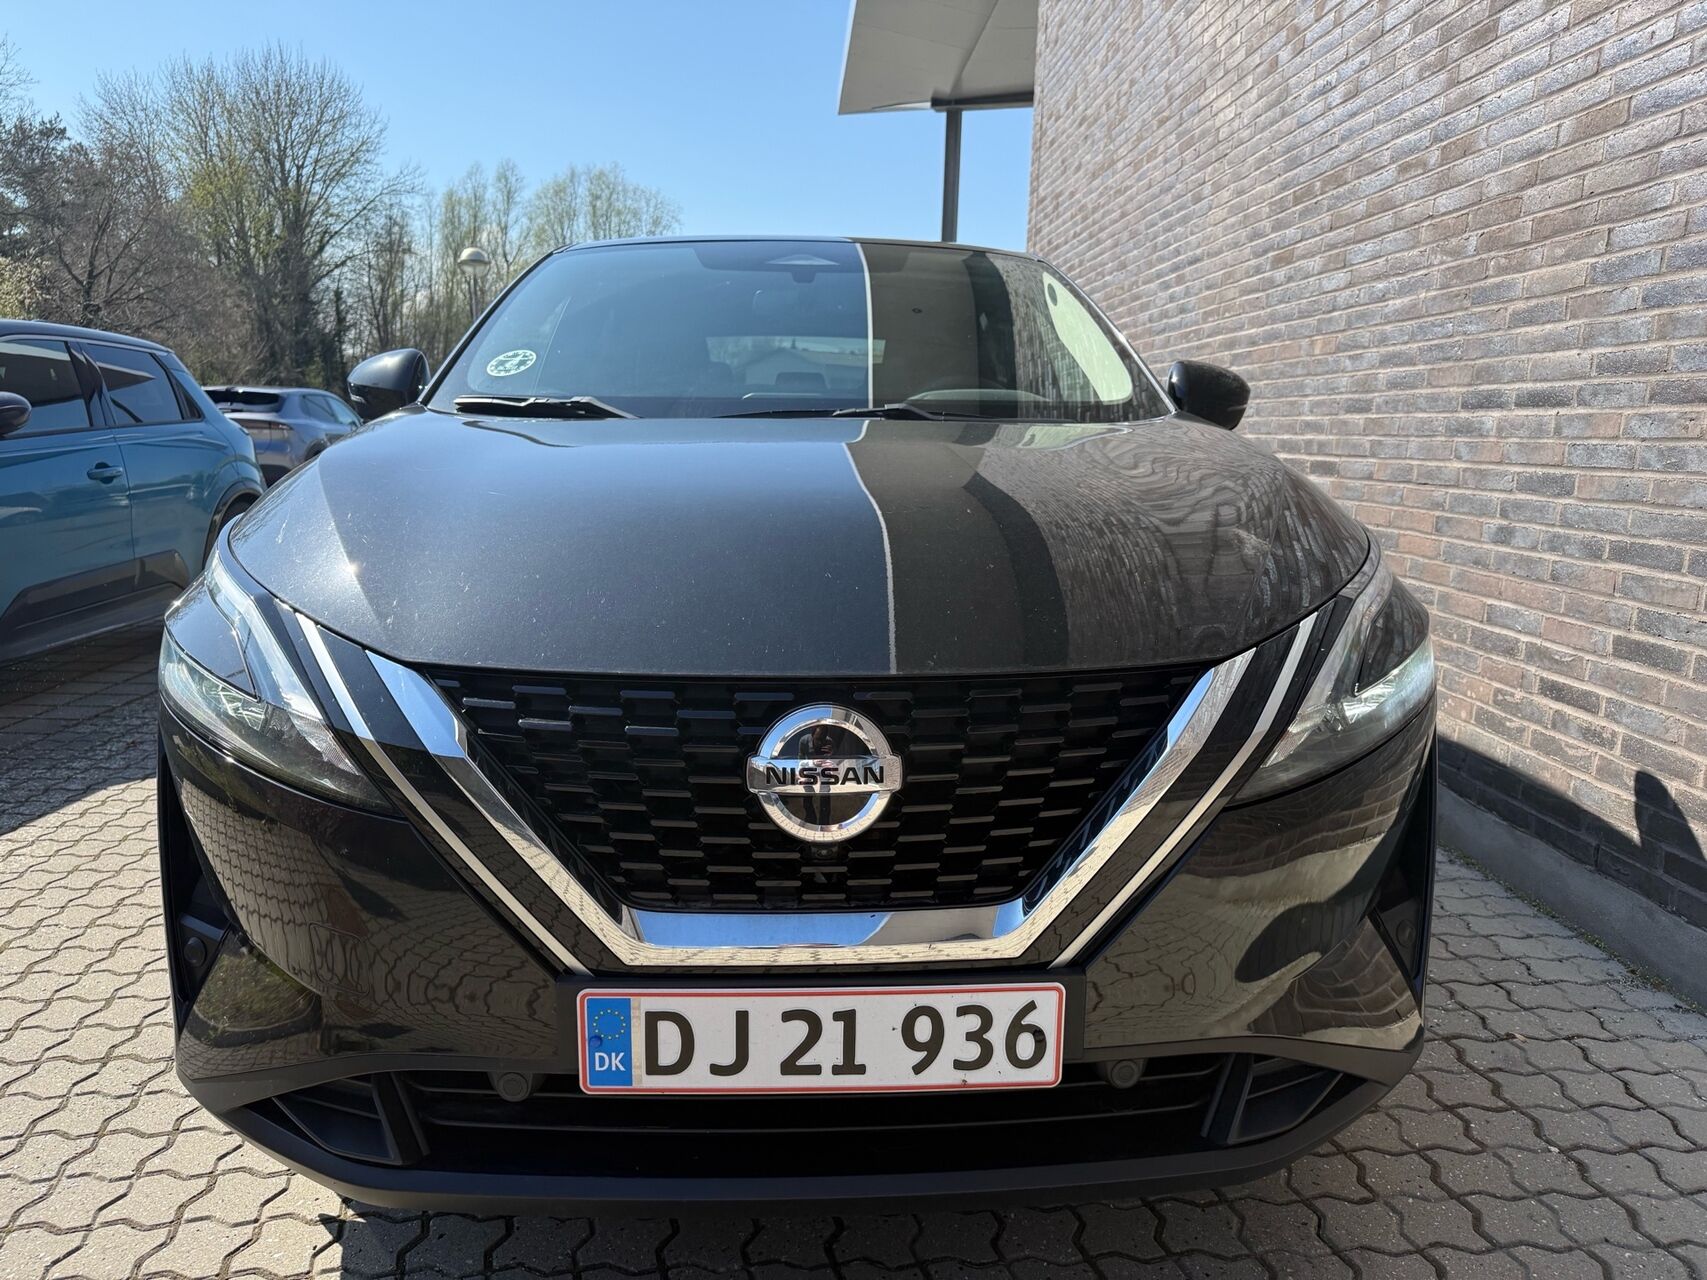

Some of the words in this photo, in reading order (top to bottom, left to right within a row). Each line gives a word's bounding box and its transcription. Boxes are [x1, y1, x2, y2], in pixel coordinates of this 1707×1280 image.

[766, 766, 884, 785] NISSAN
[645, 1009, 750, 1076] DJ
[779, 1008, 867, 1075] 21
[900, 1000, 1047, 1075] 936
[594, 1051, 626, 1072] DK
